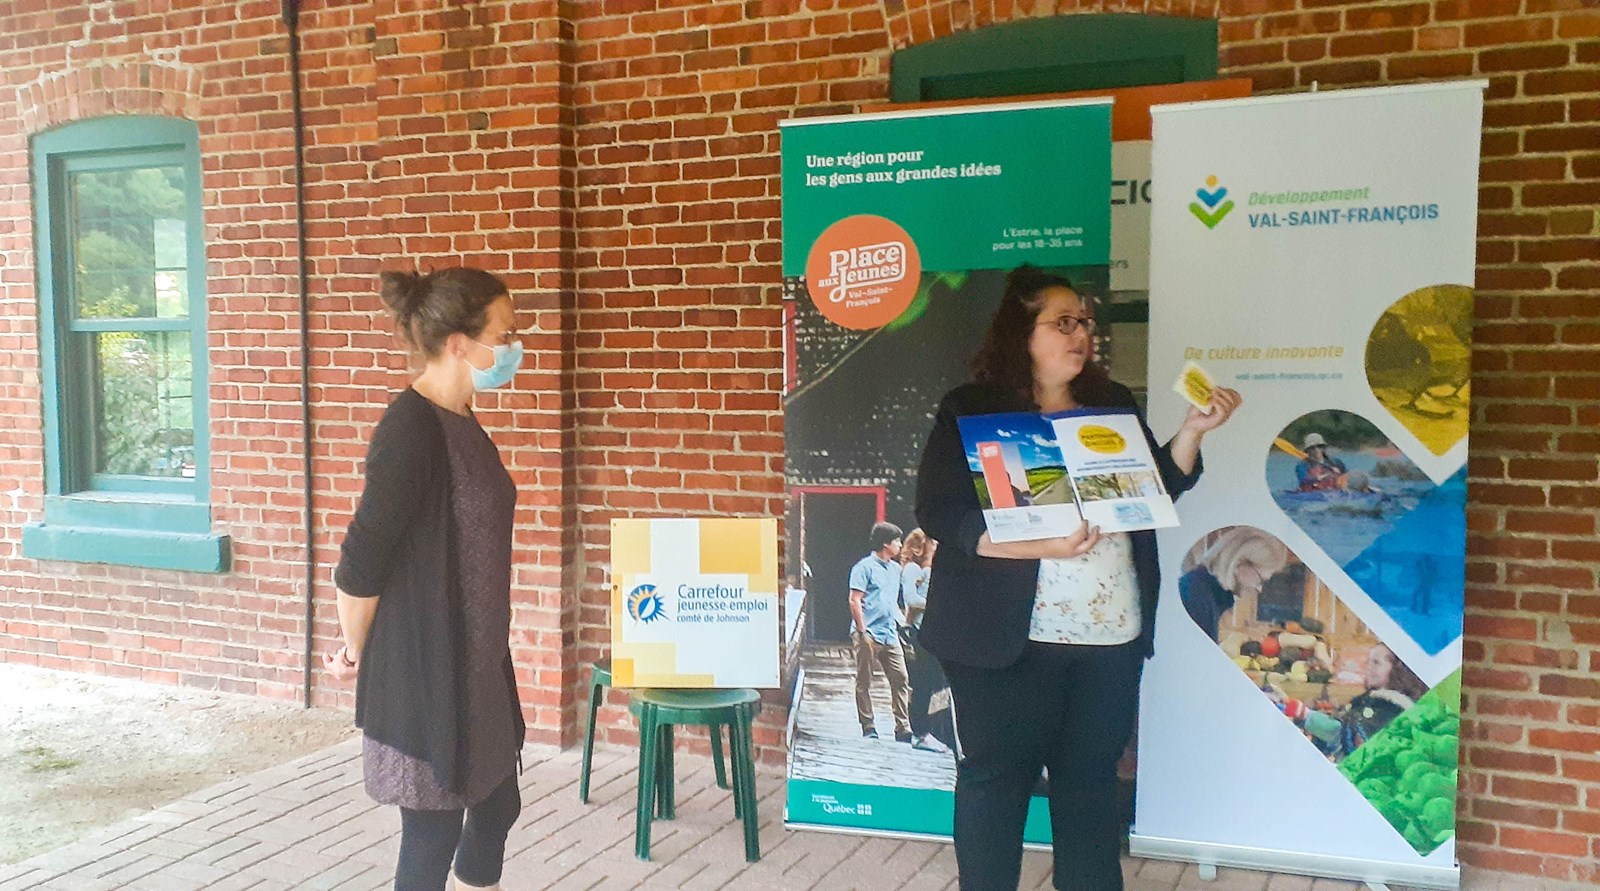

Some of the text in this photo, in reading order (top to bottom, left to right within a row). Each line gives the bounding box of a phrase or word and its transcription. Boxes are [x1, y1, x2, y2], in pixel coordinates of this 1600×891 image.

[805, 150, 924, 168] Une région pour
[805, 162, 1002, 188] les gens aux grandes idées
[1248, 186, 1371, 206] Développement
[1248, 203, 1440, 229] VAL-SAINT-FRANÇOIS
[1055, 226, 1083, 237] place
[992, 242, 1015, 251] pour
[1017, 241, 1032, 249] les
[829, 247, 900, 277] Place
[818, 263, 900, 303] aux Jeunes
[1184, 345, 1345, 360] De culture innovante
[677, 583, 745, 599] Carrefour
[676, 613, 750, 623] comté de Johnson
[823, 803, 855, 814] Québec
